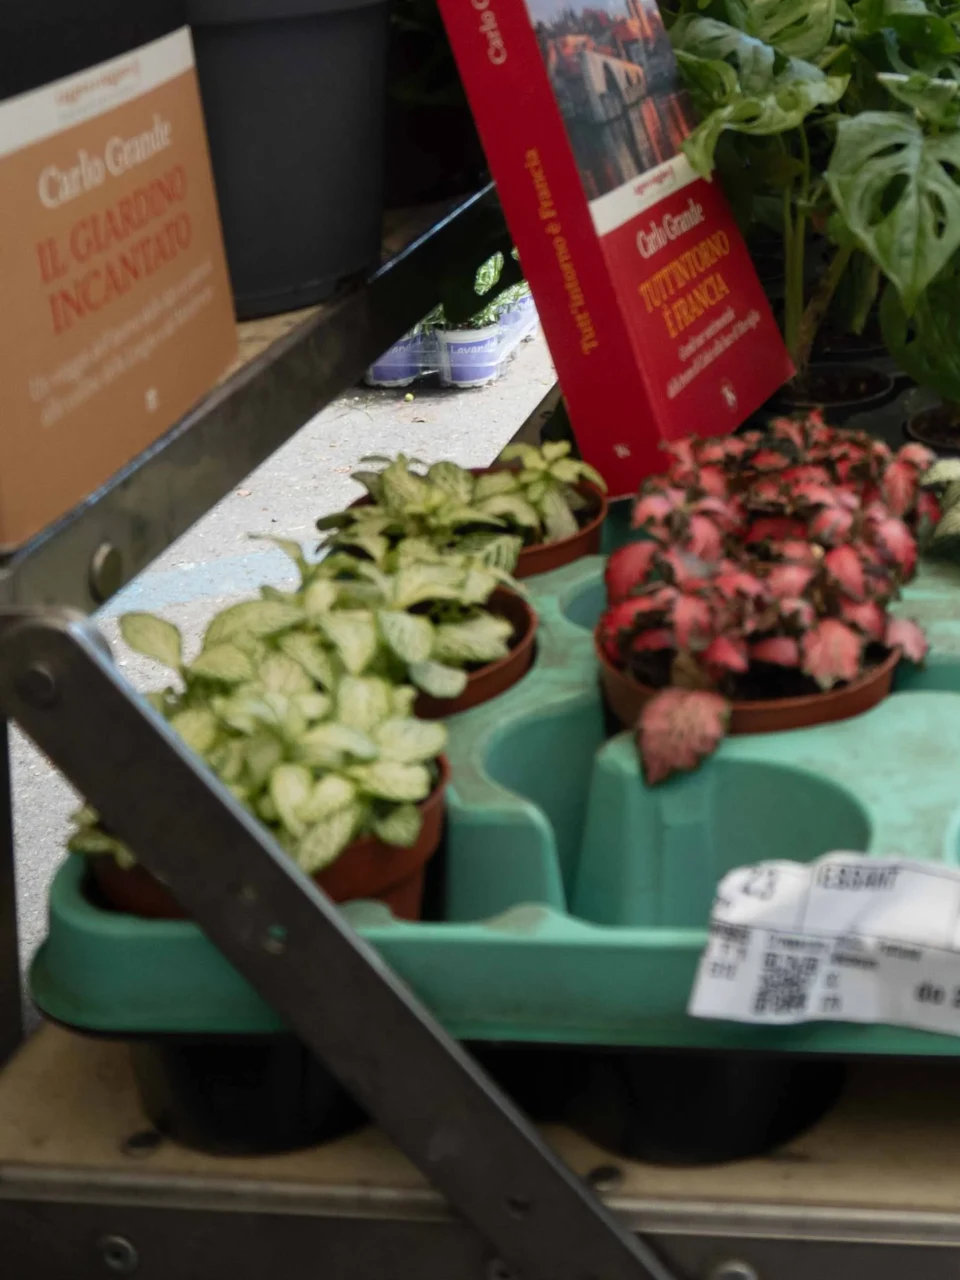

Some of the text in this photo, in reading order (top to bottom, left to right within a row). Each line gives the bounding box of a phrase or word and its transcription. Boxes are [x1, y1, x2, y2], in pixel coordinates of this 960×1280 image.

[478, 10, 508, 65] Carlo
[38, 112, 172, 210] Carlo Grande
[525, 147, 558, 220] Francia
[36, 163, 188, 284] IL GIARDINO
[636, 198, 705, 260] Carlo Grande
[49, 211, 193, 336] INCANTATO
[673, 272, 731, 334] FRANCIA
